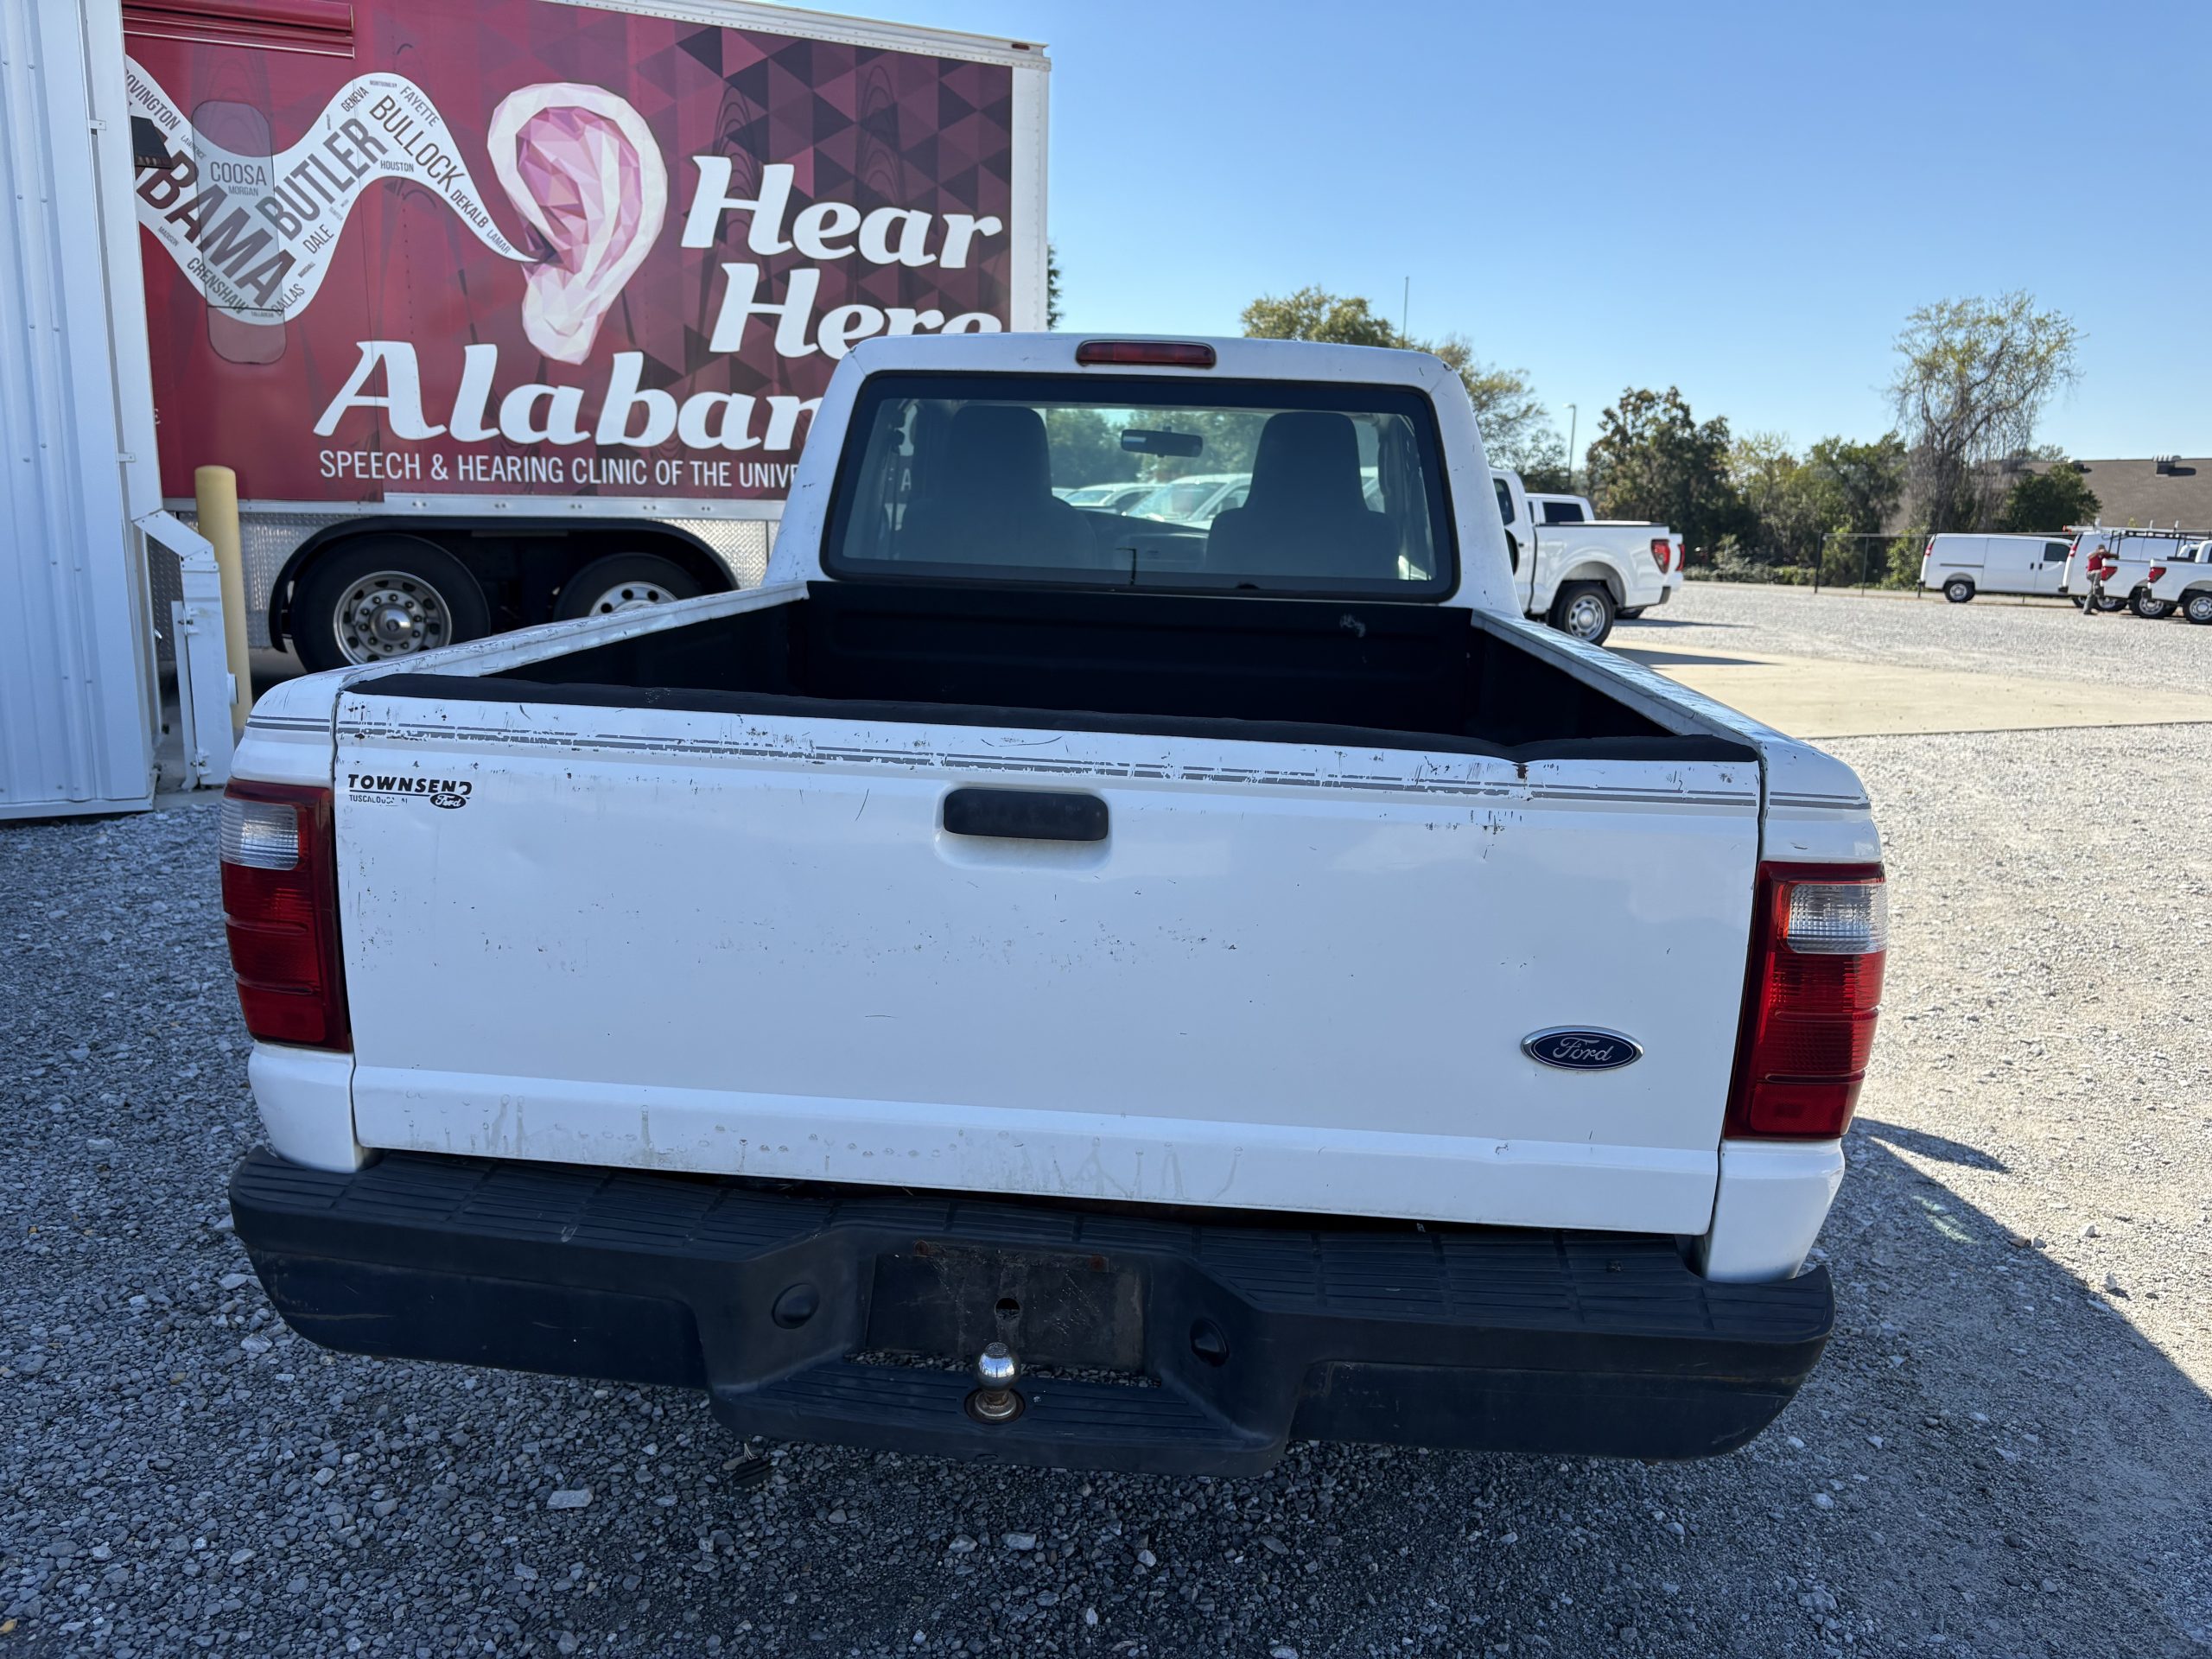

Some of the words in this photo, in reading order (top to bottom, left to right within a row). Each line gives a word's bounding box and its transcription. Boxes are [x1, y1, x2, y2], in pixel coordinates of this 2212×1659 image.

[125, 68, 181, 131] OVINGTON
[340, 86, 369, 112] GENEVA
[399, 86, 440, 127] FAYETTE
[369, 95, 466, 194] BULLOCK
[210, 161, 268, 187] COOSA
[255, 118, 389, 241] BUTLER
[380, 160, 415, 173] HOUSTON
[228, 185, 259, 197] MORGAN
[450, 189, 489, 229] DEKALB
[681, 155, 1003, 269] Hear
[302, 224, 335, 254] DALE
[486, 229, 512, 254] LAMAR
[187, 257, 249, 315] CRENSHAW
[270, 283, 305, 316] DALLAS
[320, 449, 422, 480] SPEECH
[431, 454, 448, 481] &
[458, 454, 564, 484] HEARING
[572, 456, 647, 486] CLINIC
[655, 459, 683, 486] OF
[690, 461, 732, 488] THE
[1553, 1037, 1614, 1061] Ford
